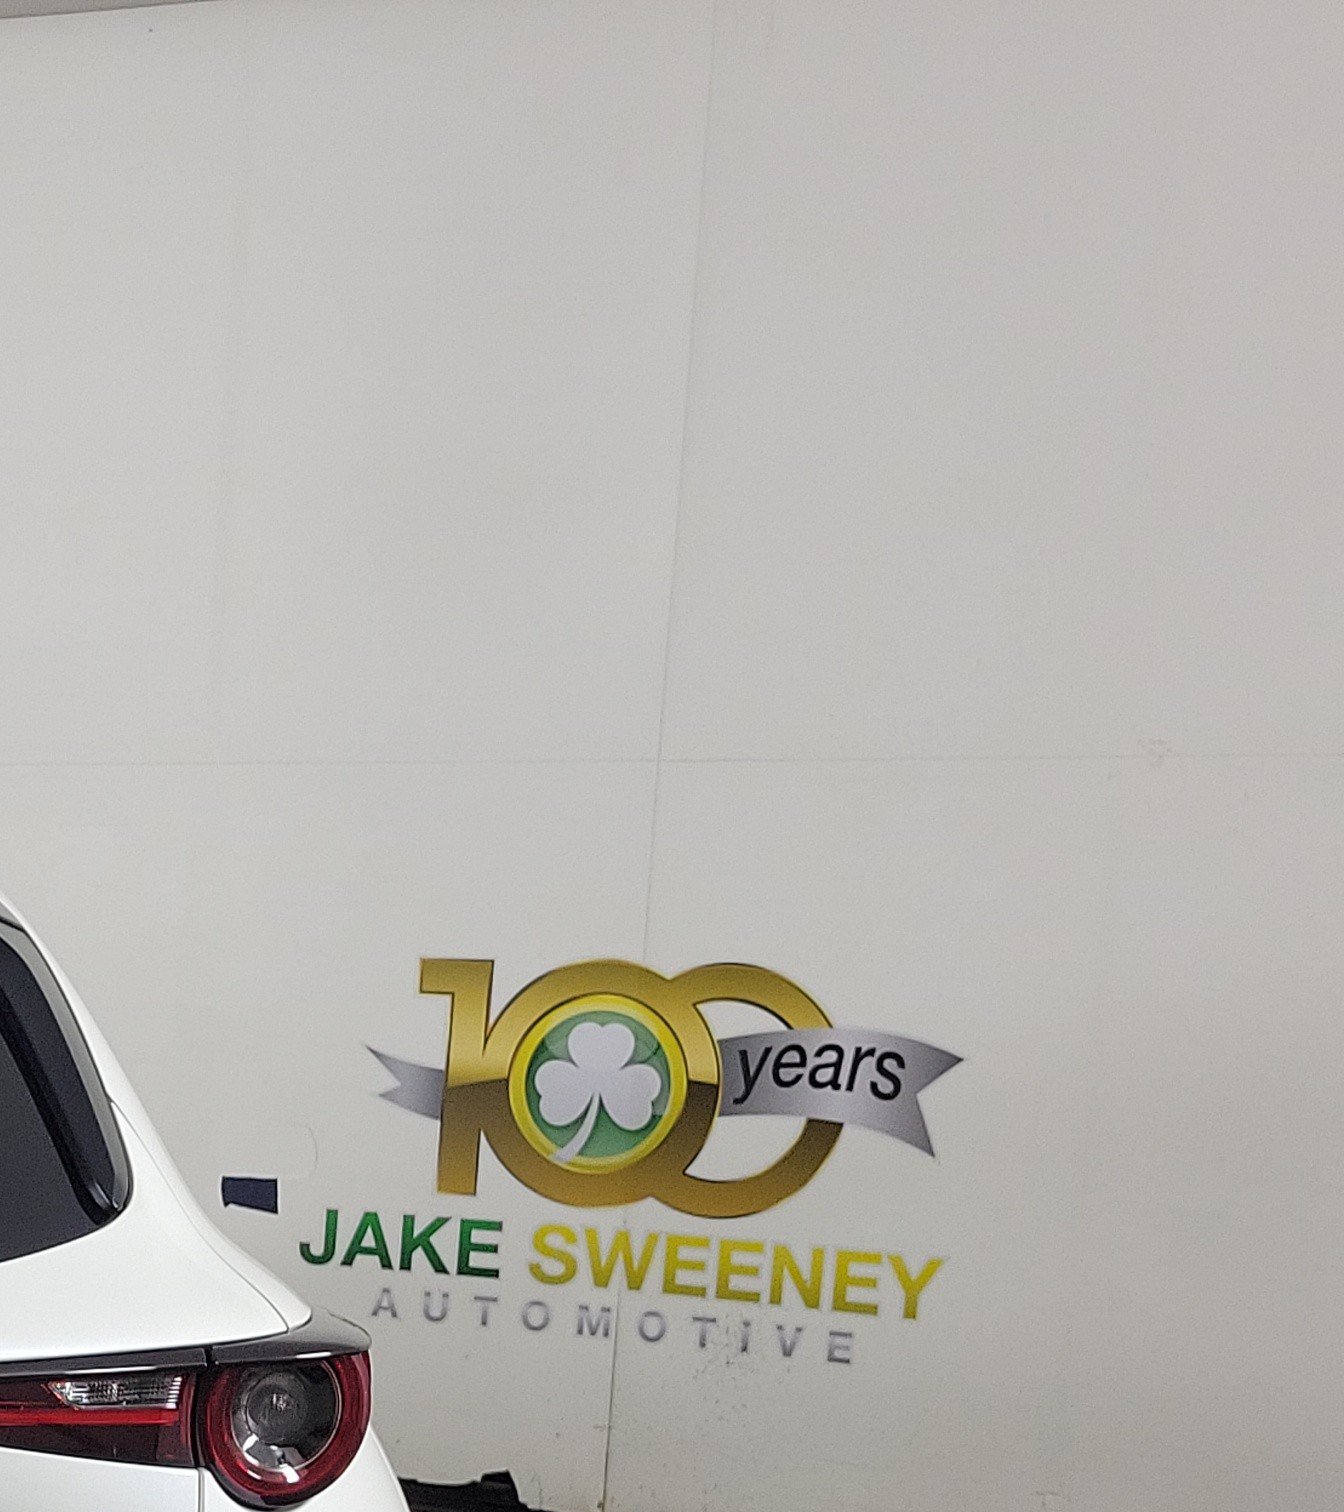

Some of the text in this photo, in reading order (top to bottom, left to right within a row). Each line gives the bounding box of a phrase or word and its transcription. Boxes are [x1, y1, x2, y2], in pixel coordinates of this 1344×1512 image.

[419, 958, 844, 1219] 100
[732, 1042, 906, 1105] years
[298, 1208, 946, 1321] JAKE SWEENEY
[370, 1286, 855, 1365] AUTOMOTIVE
